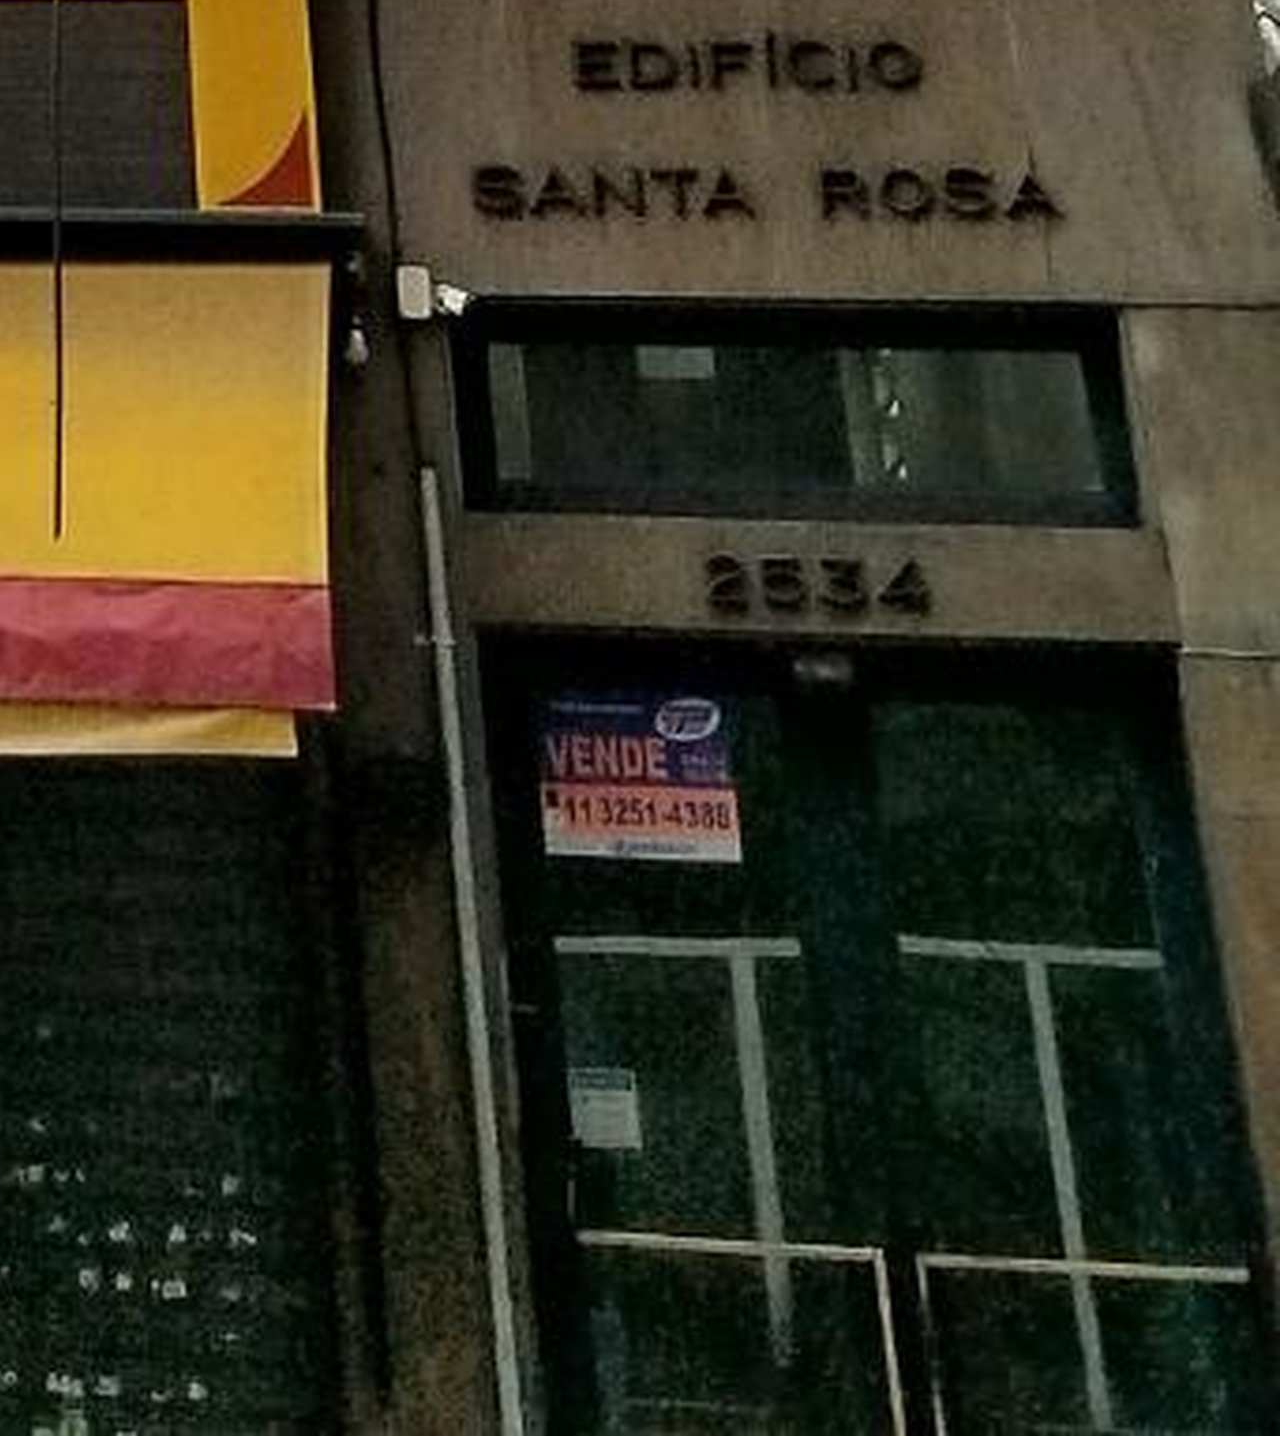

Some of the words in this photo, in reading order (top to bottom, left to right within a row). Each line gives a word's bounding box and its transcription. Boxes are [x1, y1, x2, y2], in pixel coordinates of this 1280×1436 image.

[472, 165, 756, 222] SANTA
[820, 165, 1067, 223] ROSA
[704, 556, 933, 618] 2534
[544, 733, 669, 779] VENDE
